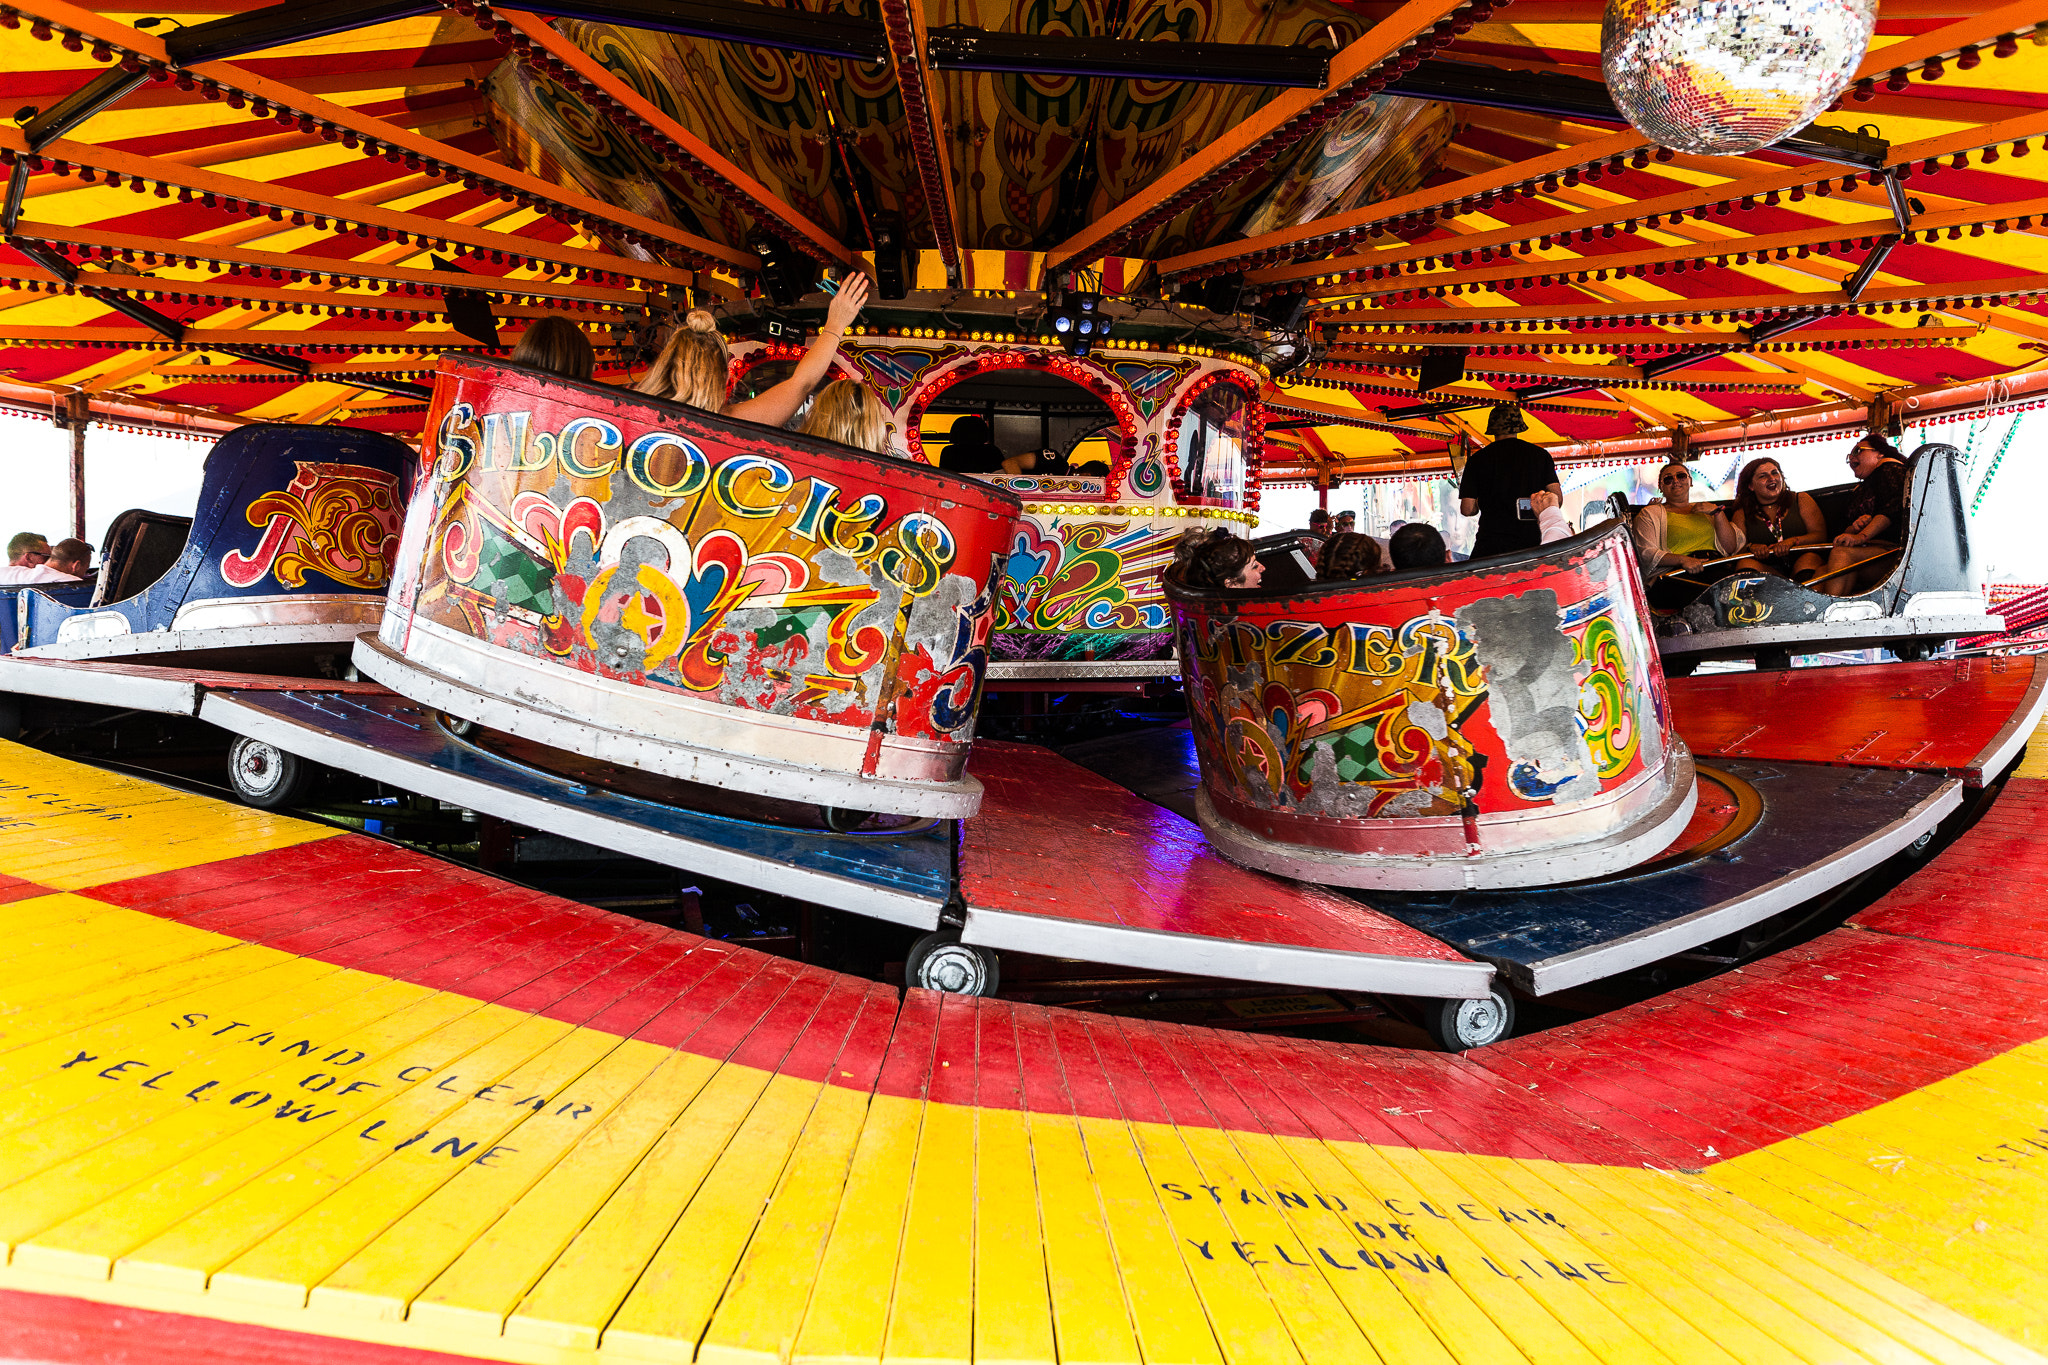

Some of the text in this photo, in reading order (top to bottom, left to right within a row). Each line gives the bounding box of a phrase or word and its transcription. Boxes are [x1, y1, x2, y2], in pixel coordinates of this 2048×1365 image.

[433, 402, 957, 598] SILCOCKS
[171, 1013, 593, 1120] STAND CLEAR
[299, 1073, 381, 1095] OF
[61, 1051, 519, 1168] YELLOW LINE
[1161, 1183, 1566, 1229] STAND CLEAR
[1354, 1221, 1414, 1241] OF
[1186, 1238, 1627, 1284] YELLOW LINE
